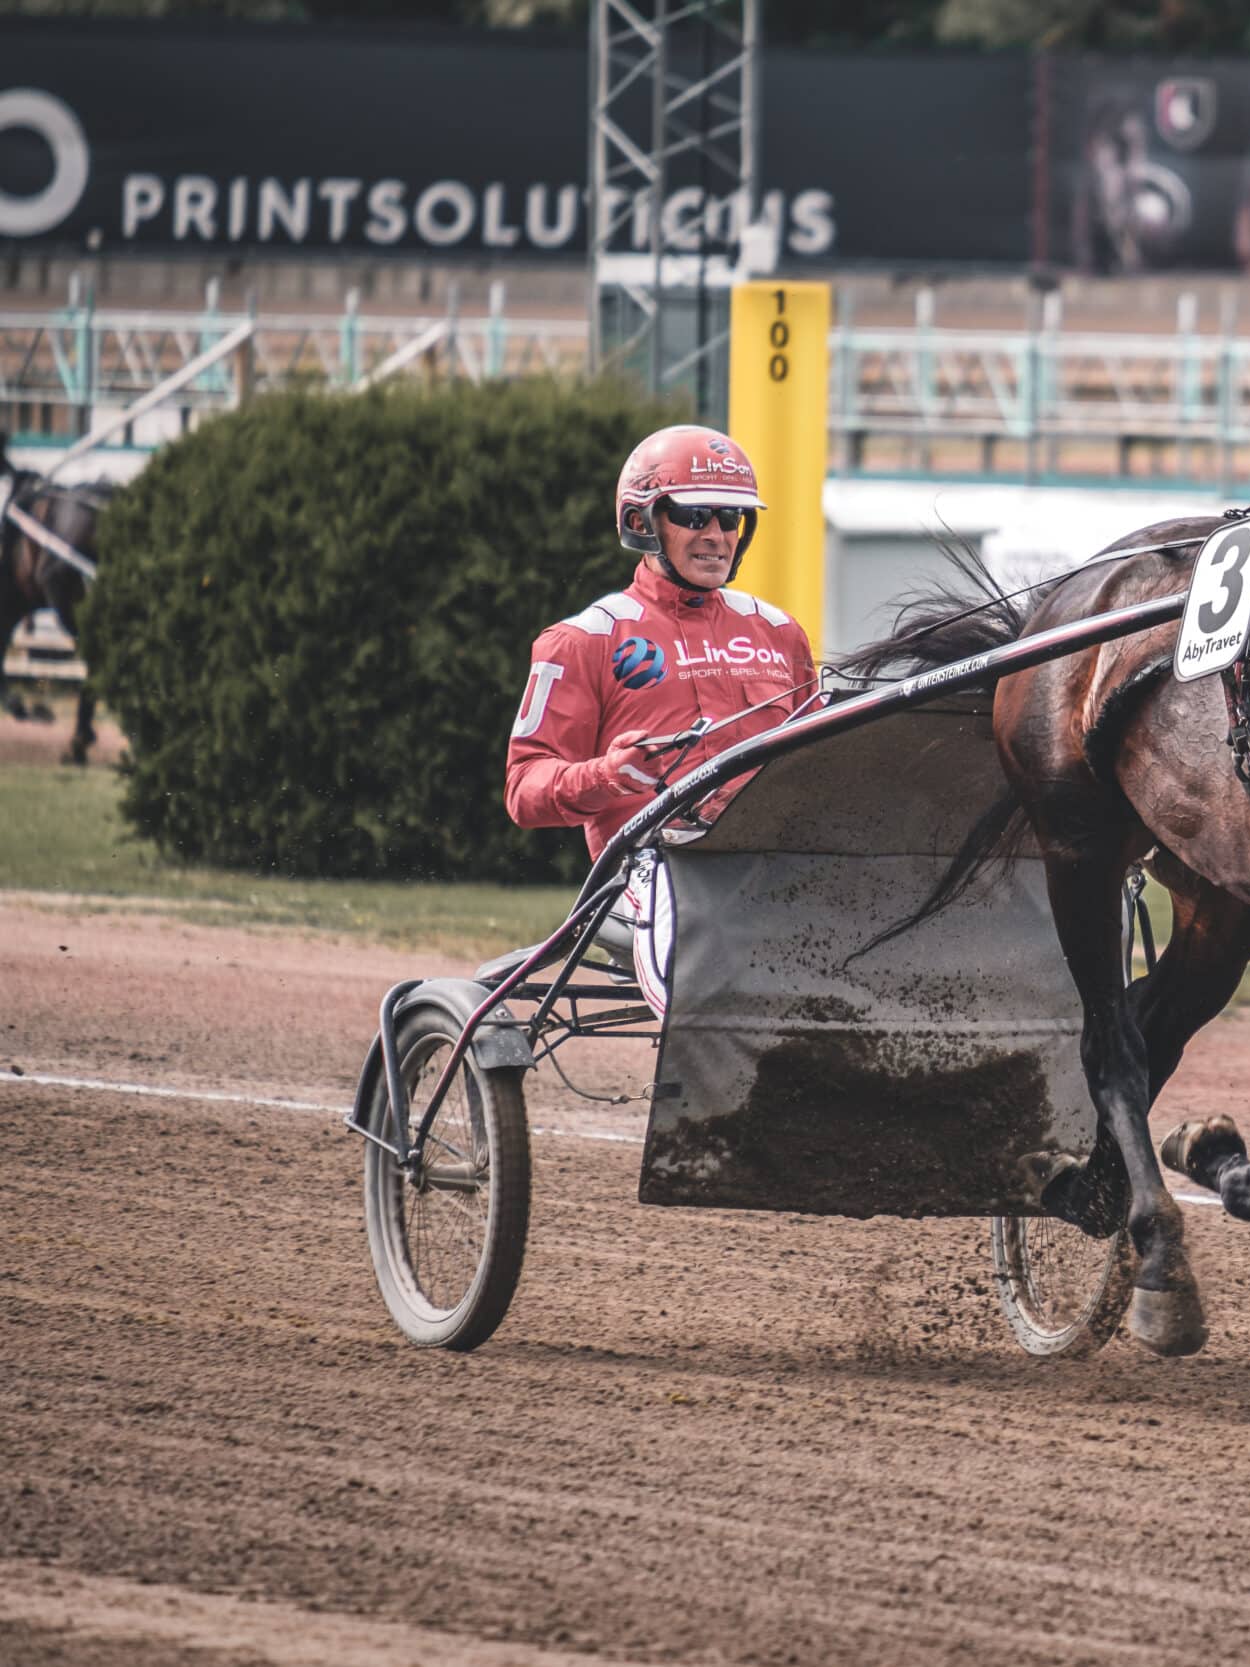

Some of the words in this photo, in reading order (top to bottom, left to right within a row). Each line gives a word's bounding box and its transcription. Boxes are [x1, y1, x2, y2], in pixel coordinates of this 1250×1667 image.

[690, 456, 752, 475] LinSon
[673, 636, 787, 666] LinSon
[1182, 631, 1242, 663] ÅbyTravet
[678, 668, 722, 680] SPORT
[730, 668, 760, 676] SPEL
